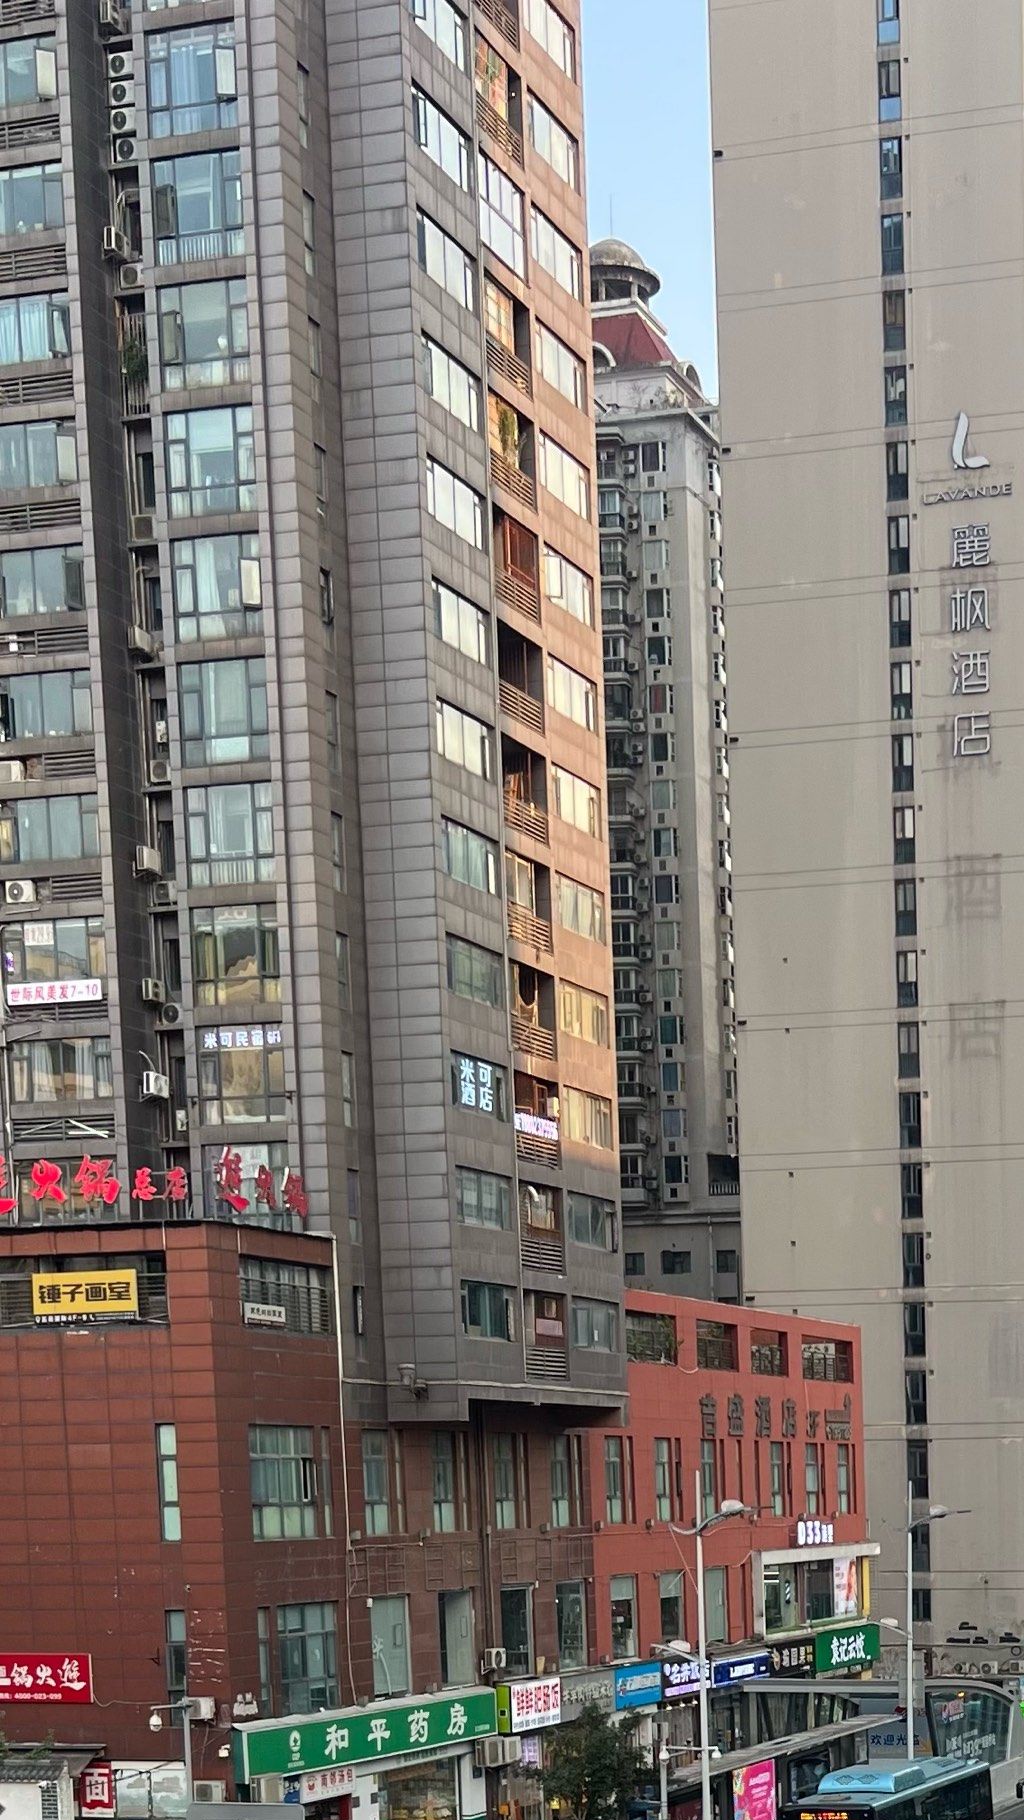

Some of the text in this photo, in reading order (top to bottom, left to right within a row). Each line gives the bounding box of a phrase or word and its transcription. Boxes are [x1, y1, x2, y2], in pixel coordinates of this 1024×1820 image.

[922, 481, 1013, 506] LAVANDE
[951, 523, 992, 758] 麗枫酒店
[460, 1059, 492, 1087] 米可
[461, 1080, 493, 1112] 酒店
[38, 1281, 132, 1305] 锤子画室
[831, 1632, 866, 1665] 袁记云饺
[324, 1702, 468, 1761] 和平药房
[86, 1771, 110, 1804] 面
